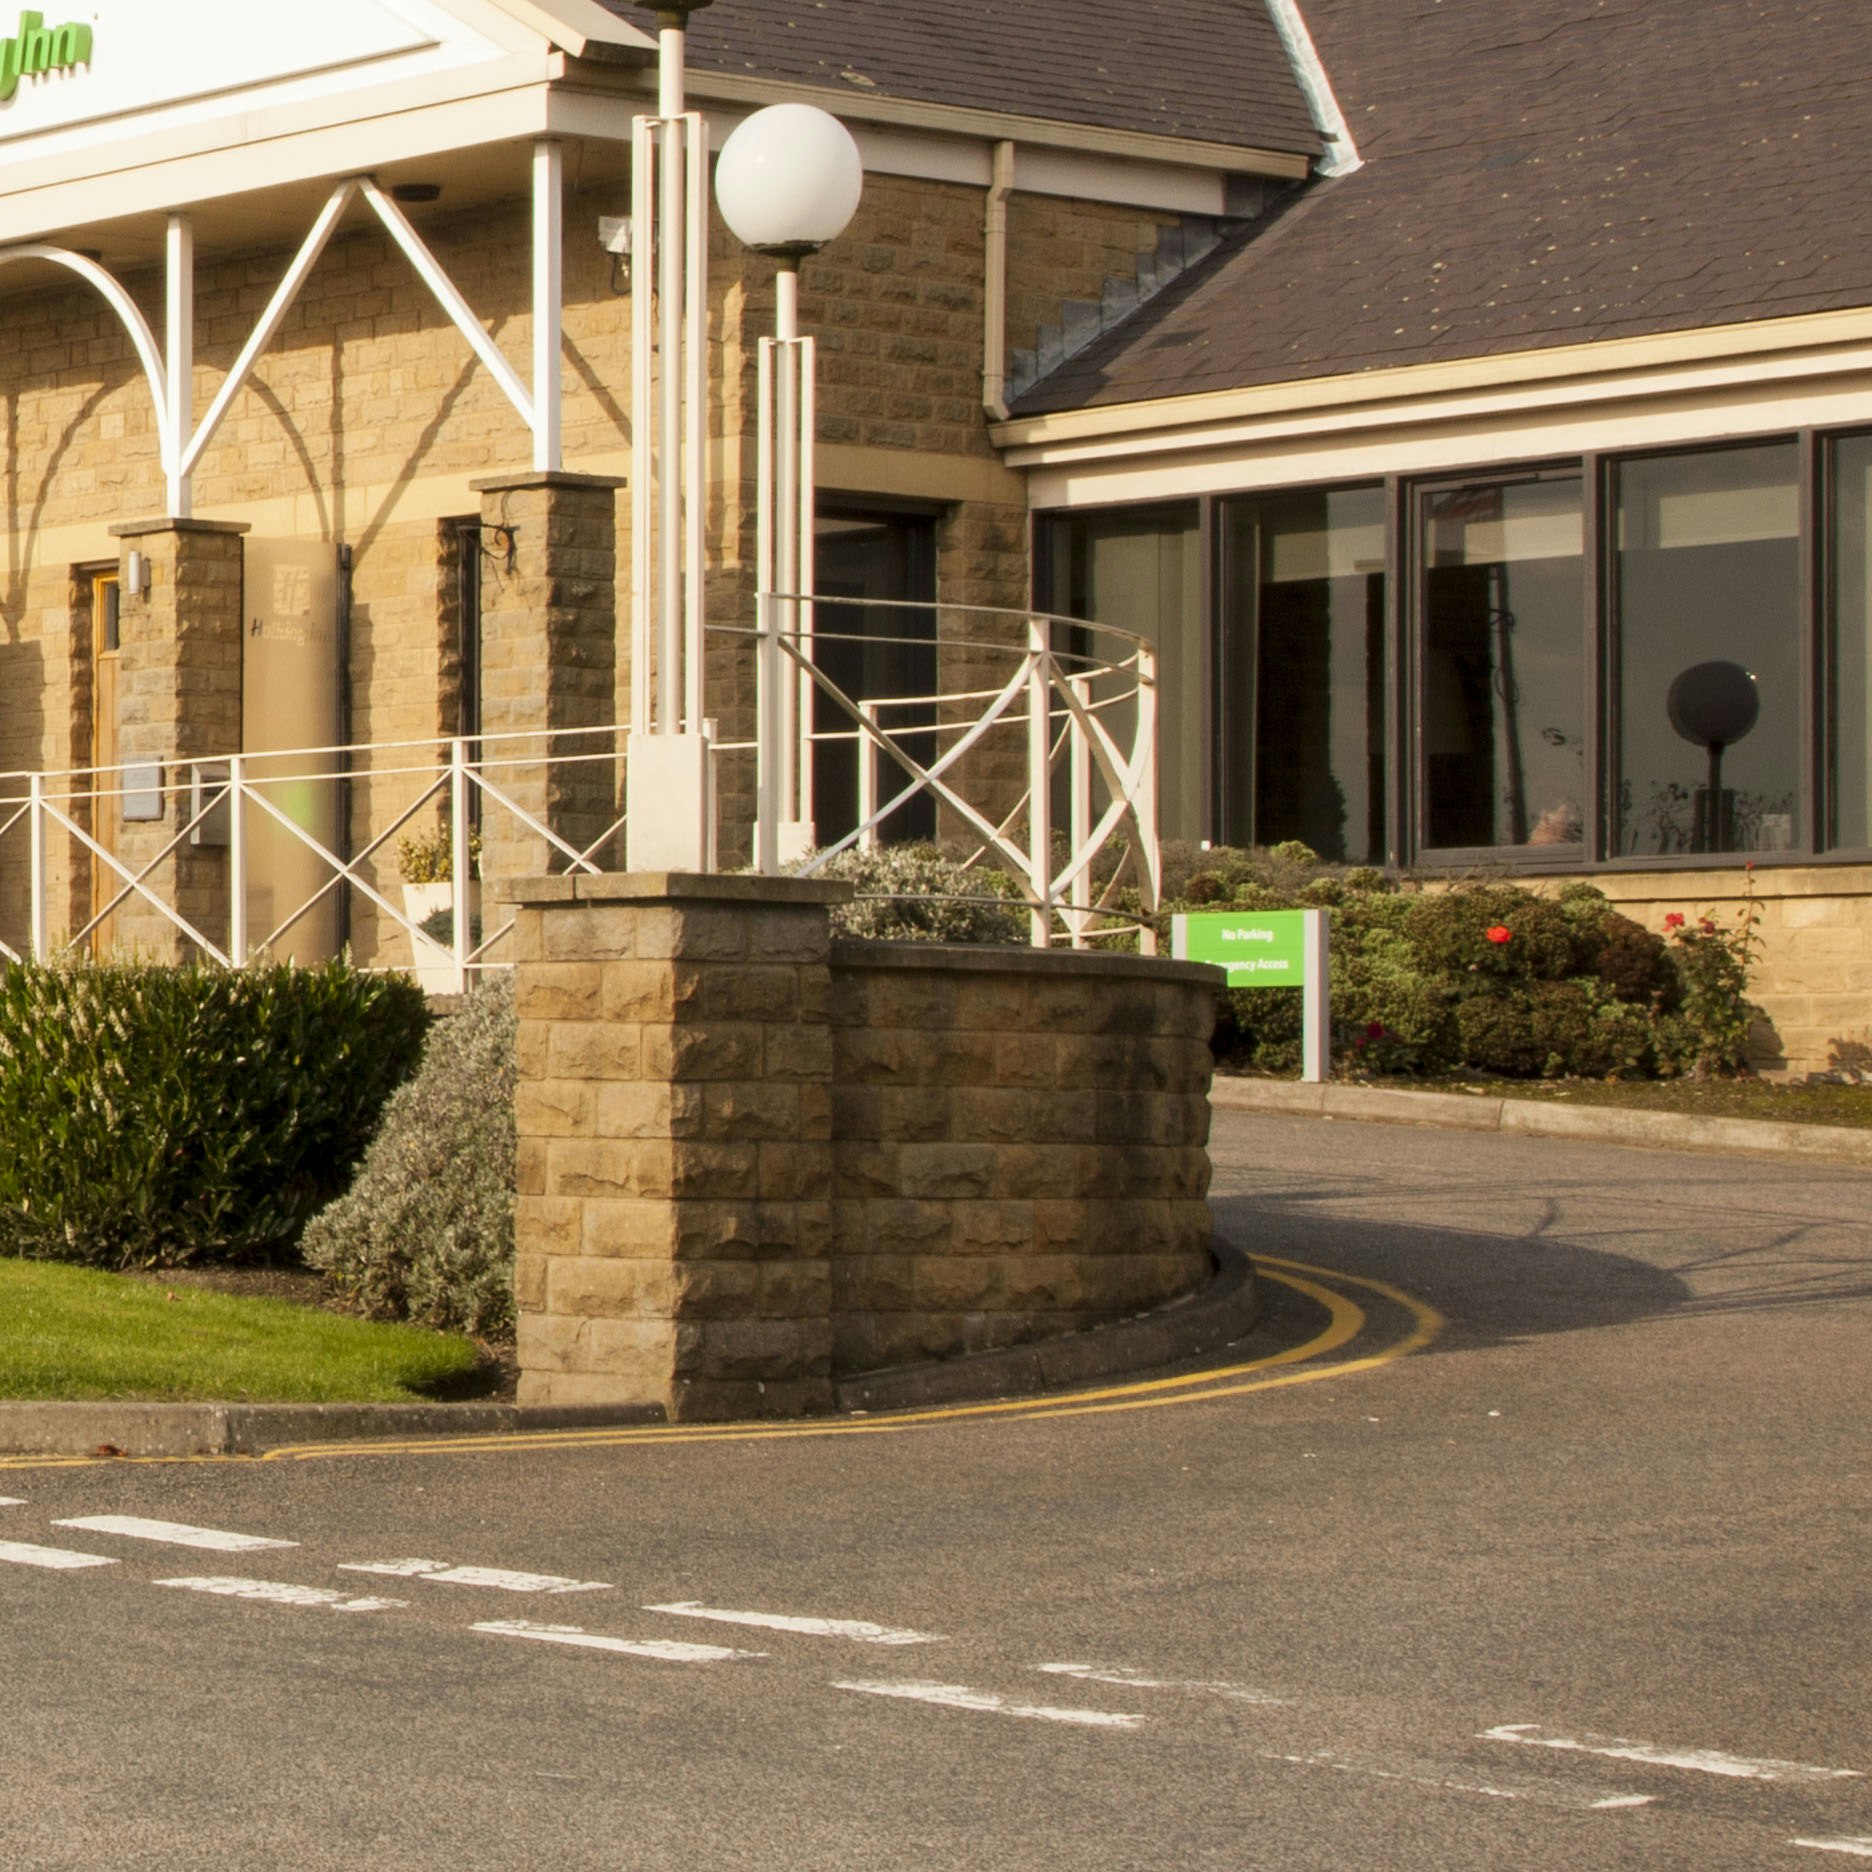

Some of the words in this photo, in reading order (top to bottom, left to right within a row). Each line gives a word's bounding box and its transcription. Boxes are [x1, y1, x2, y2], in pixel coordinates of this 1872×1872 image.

[13, 10, 92, 75] Inn
[1221, 929, 1236, 940] No
[1237, 928, 1274, 942] Parking
[1257, 958, 1288, 969] Access
